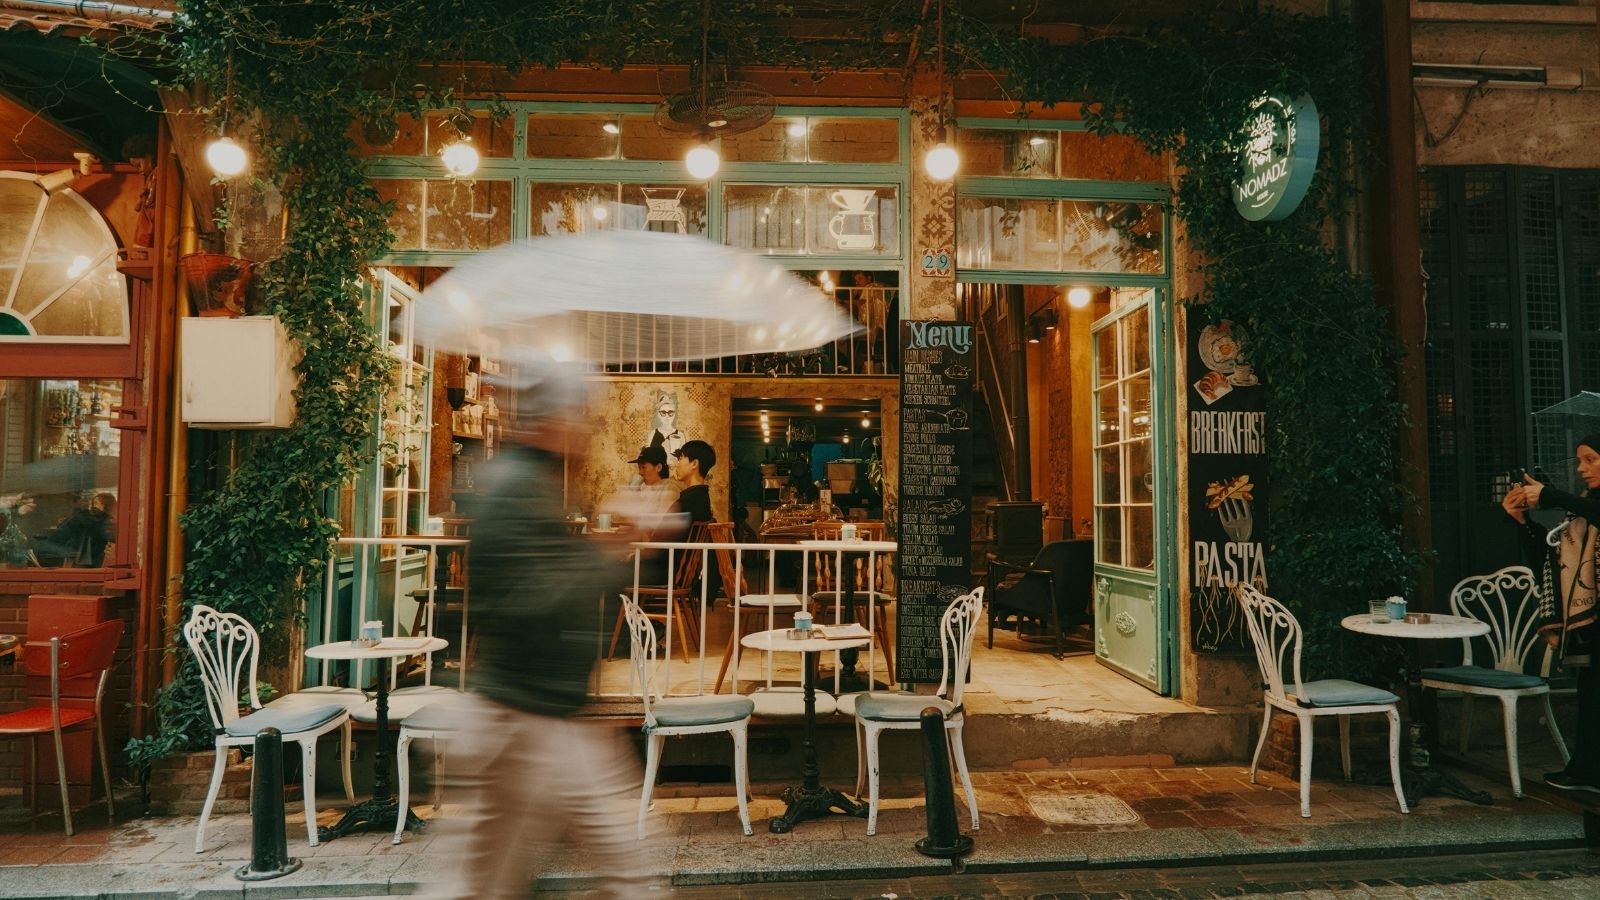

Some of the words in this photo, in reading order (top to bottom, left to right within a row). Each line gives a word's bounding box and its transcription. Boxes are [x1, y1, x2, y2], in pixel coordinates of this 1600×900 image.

[1239, 158, 1288, 202] NOMADZ
[925, 255, 948, 269] 29
[905, 318, 973, 354] Menu
[904, 364, 931, 374] MEATBALL
[925, 375, 942, 385] PLATE
[904, 384, 938, 395] VEGETARIAN
[939, 385, 956, 396] PLATE
[903, 422, 920, 433] PENNE
[1191, 410, 1267, 455] BREAKFAST
[903, 433, 920, 443] PENNE
[919, 514, 937, 524] SALAD
[922, 535, 939, 545] SALAD
[1194, 541, 1269, 589] PASTA
